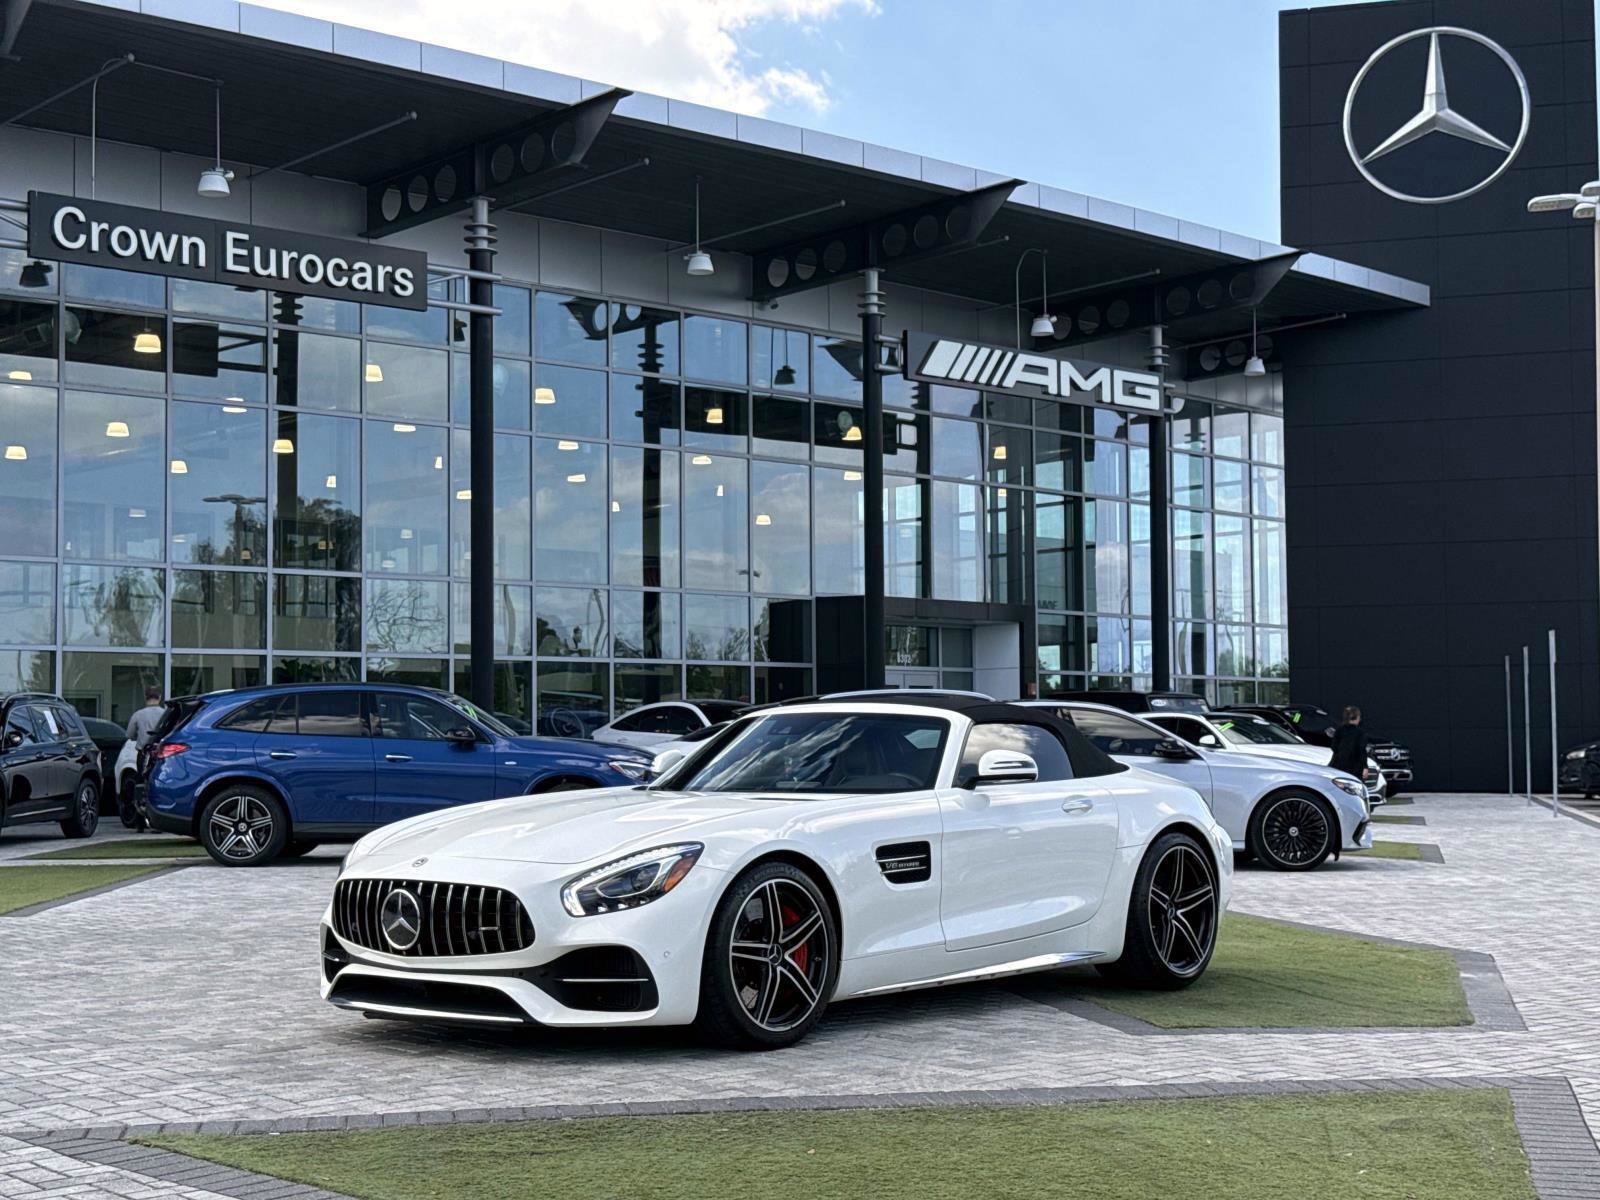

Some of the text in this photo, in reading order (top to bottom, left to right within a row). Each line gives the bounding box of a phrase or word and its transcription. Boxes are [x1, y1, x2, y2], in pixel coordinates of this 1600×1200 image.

[53, 206, 414, 297] Crown Eurocars
[1003, 353, 1160, 411] AMG
